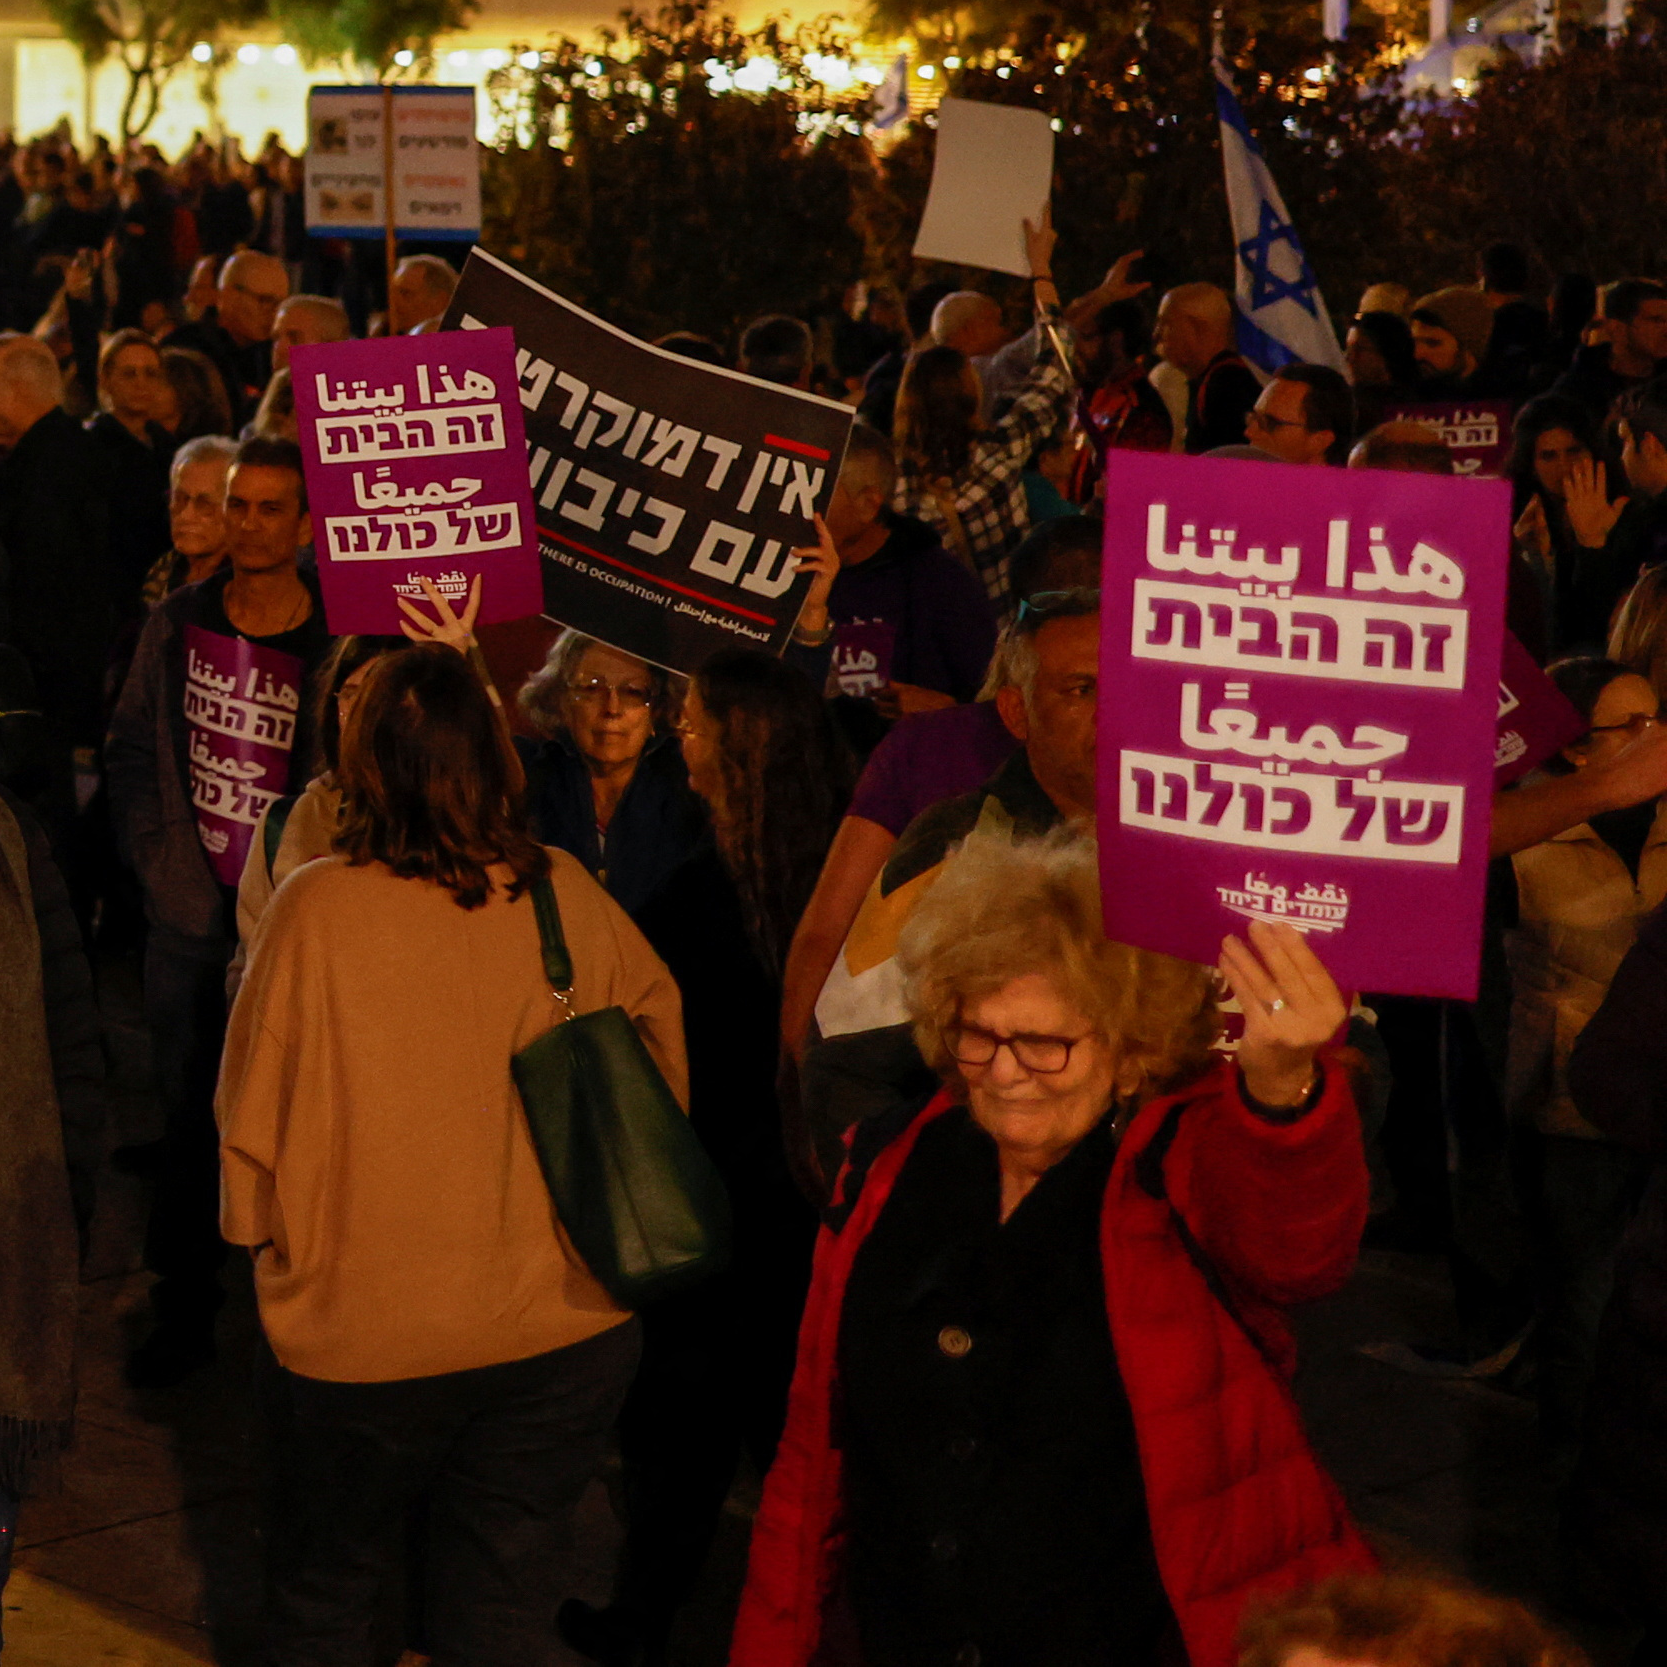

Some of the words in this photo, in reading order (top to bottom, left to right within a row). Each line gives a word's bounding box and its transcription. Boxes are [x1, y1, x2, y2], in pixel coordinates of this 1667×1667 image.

[315, 372, 405, 418] بيتنا
[416, 364, 497, 405] هذا
[326, 420, 435, 455] הבית
[447, 414, 494, 445] זה
[735, 449, 826, 521] אין
[333, 516, 437, 553] כולנו
[447, 511, 511, 546] של
[1145, 503, 1301, 600] بيتنا
[537, 543, 573, 568] THERE
[575, 561, 588, 573] IS
[589, 567, 665, 605] OCCUPATION
[689, 519, 803, 600] עם
[1326, 519, 1466, 602] هذا
[1144, 594, 1340, 664] הבית
[1363, 616, 1453, 673] זה
[188, 648, 237, 698] بيتنا
[244, 667, 300, 712] هذا
[186, 689, 247, 731] הבית
[255, 713, 293, 742] זה
[1130, 762, 1314, 836] כולנו
[1335, 776, 1451, 847] של
[1216, 887, 1266, 911] ביחד
[1271, 898, 1348, 920] עומדים
